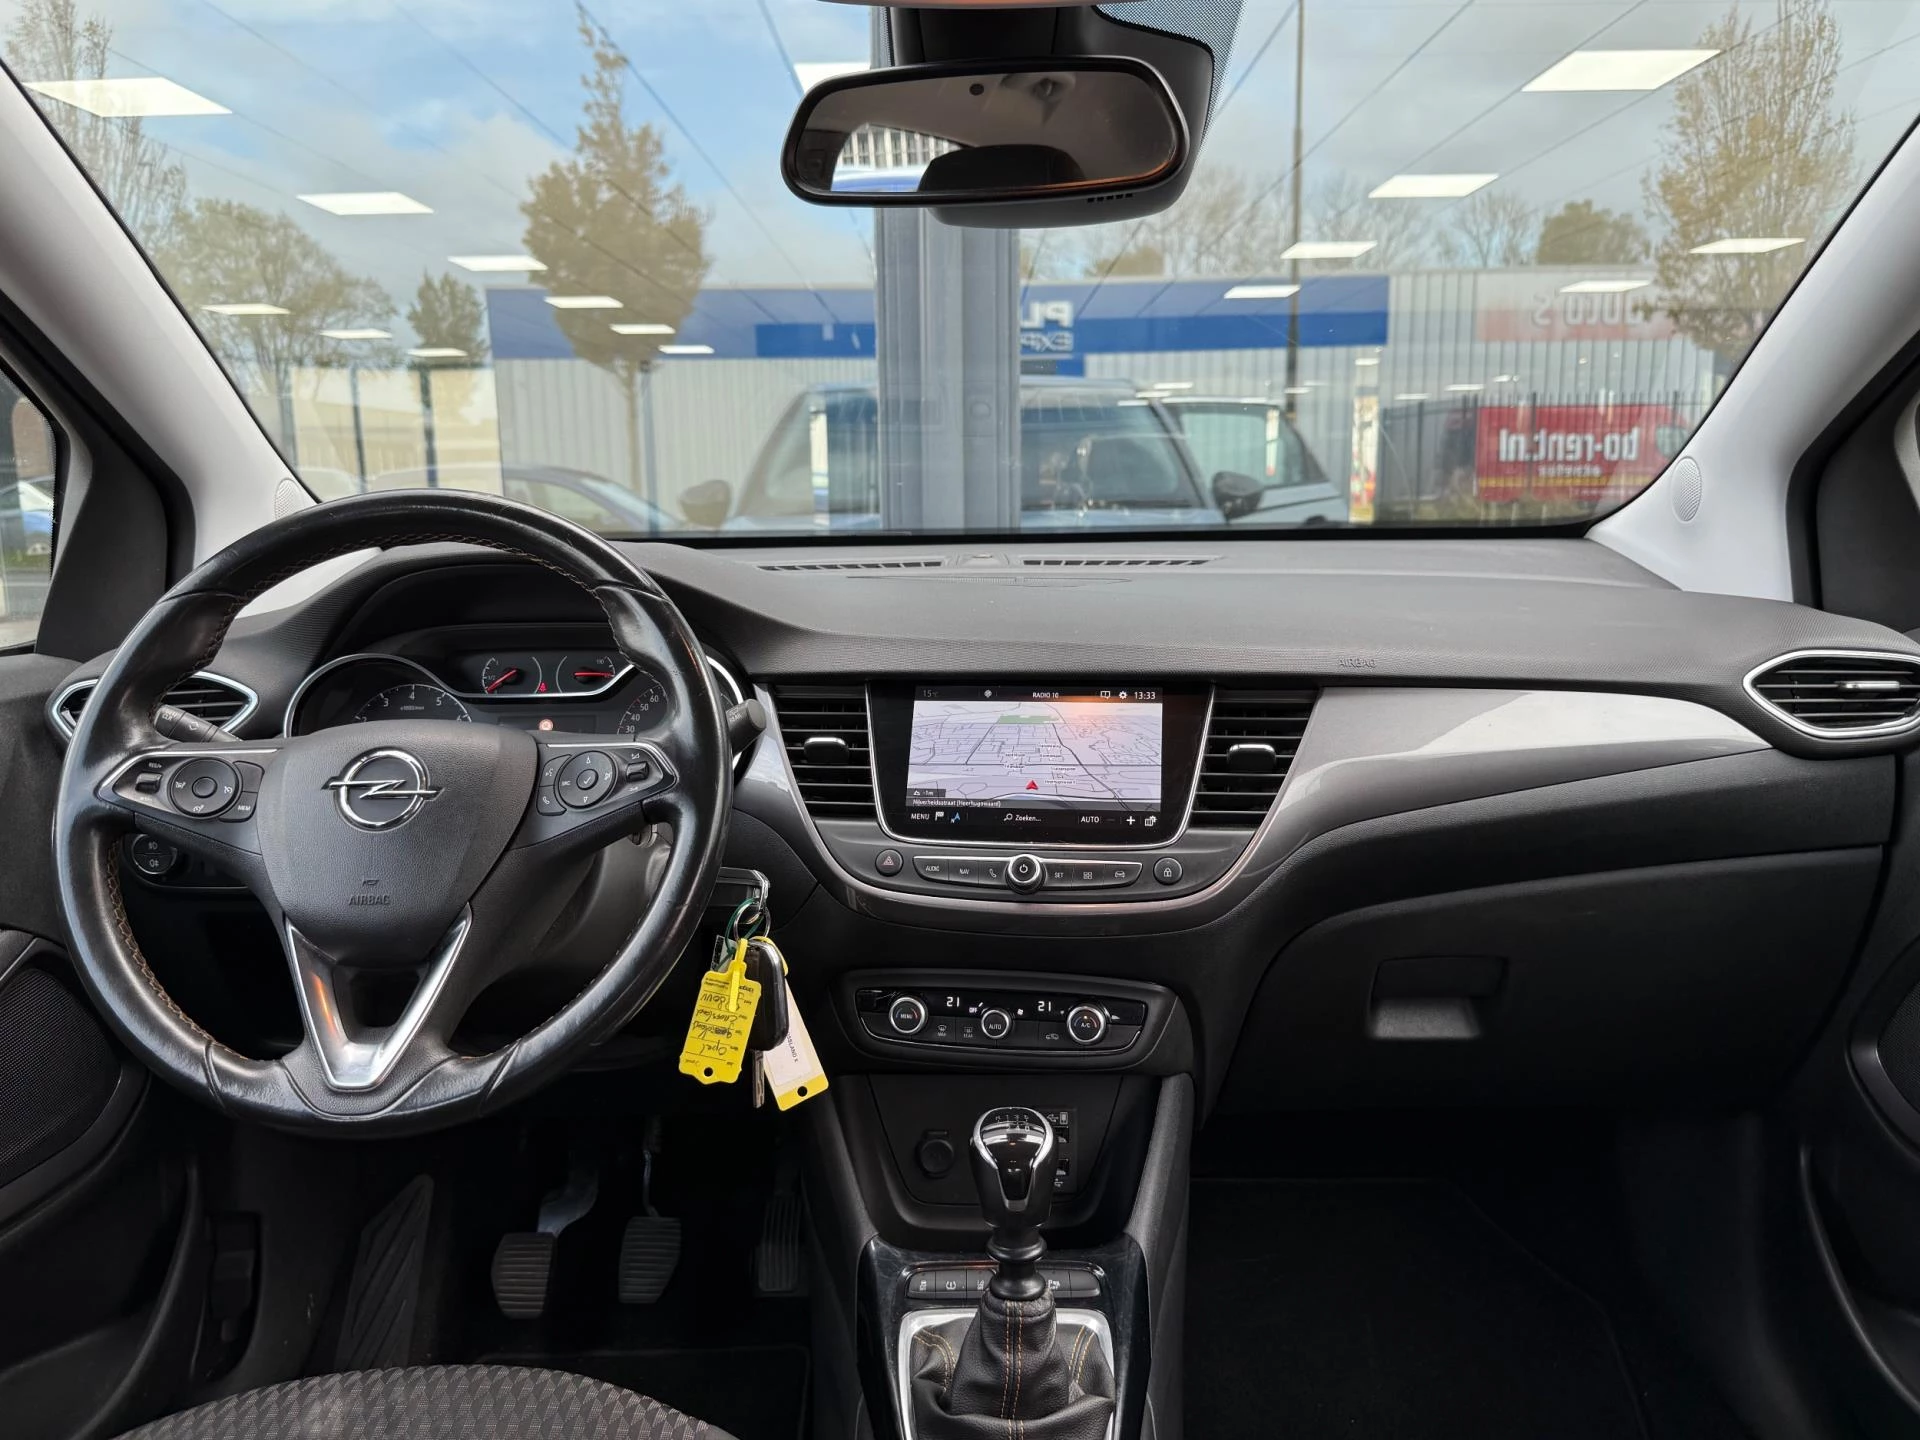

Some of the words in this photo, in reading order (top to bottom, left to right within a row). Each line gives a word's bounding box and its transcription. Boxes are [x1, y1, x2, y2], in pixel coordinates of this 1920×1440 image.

[409, 692, 415, 700] 4
[649, 695, 659, 703] 60
[1134, 691, 1156, 700] 13:33
[383, 698, 389, 707] 3
[436, 697, 442, 706] 5
[631, 713, 640, 721] 40
[625, 725, 635, 733] 30
[1080, 815, 1100, 823] AUTO
[349, 895, 391, 906] AIRBAG
[946, 996, 960, 1008] 21
[1037, 1000, 1052, 1012] 21
[700, 1040, 727, 1056] Opel
